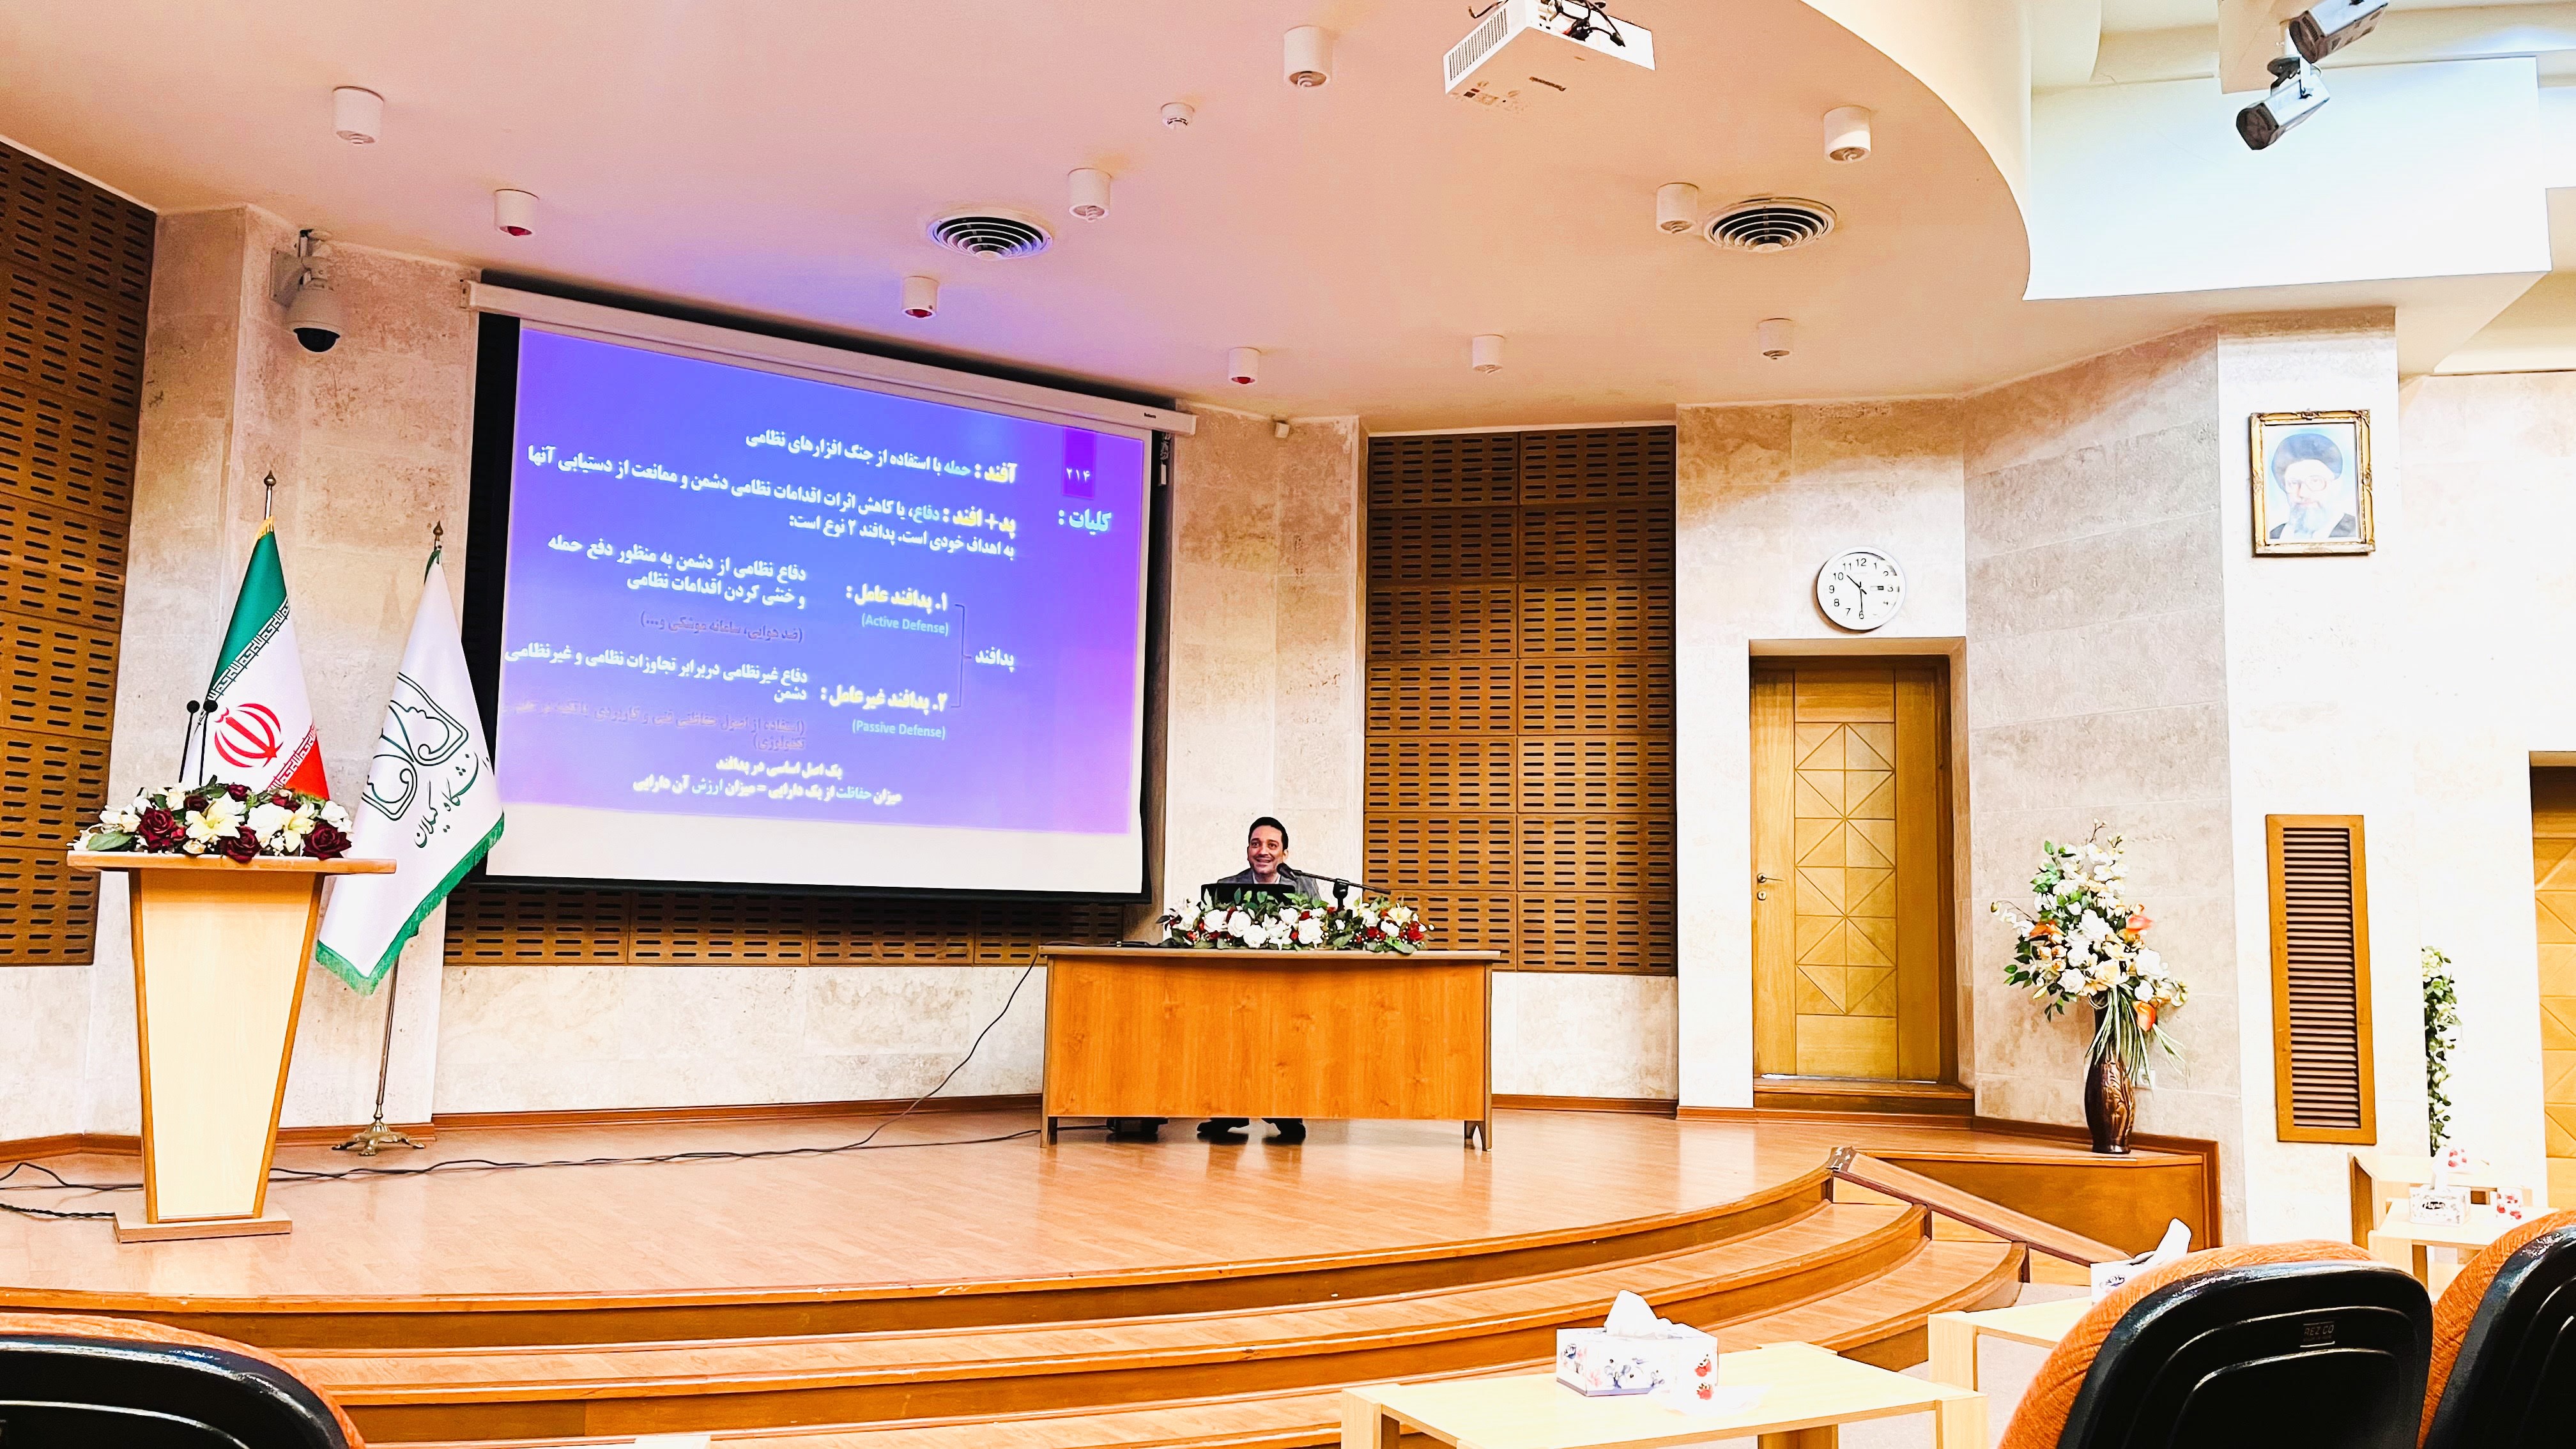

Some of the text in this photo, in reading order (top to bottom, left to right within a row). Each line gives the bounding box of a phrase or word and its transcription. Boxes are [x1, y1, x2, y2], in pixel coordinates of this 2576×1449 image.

[746, 429, 786, 447] نظامی
[528, 445, 557, 466] آنها
[558, 452, 614, 473] دستیابی
[844, 445, 874, 464] جنگ
[875, 449, 887, 467] از
[890, 452, 931, 470] استفاده
[615, 459, 631, 479] از
[631, 463, 678, 482] ممانعت
[932, 457, 942, 476] با
[944, 460, 972, 476] حمله
[983, 462, 1018, 484] آفند
[680, 475, 689, 489] و
[691, 473, 730, 491] دشمن
[731, 479, 771, 496] نظامی
[774, 484, 822, 503] اقدامات
[824, 492, 856, 512] اثرات
[858, 497, 894, 515] کاهش
[823, 519, 847, 537] نوع
[1069, 509, 1114, 535] کلیات
[859, 523, 896, 546] پدافند
[930, 535, 965, 553] خودی
[967, 537, 1002, 555] اهداف
[1002, 535, 1016, 561] به
[548, 535, 806, 583] دفاع نظامی از دشمن به منظور دفع حمله
[1856, 558, 1867, 567] 12
[1833, 572, 1844, 581] 10
[627, 570, 806, 610] و خنثی کردن اقدامات نظامی
[854, 583, 889, 606] عامل
[1828, 585, 1835, 594] 9
[891, 587, 933, 614] پدافند
[1846, 608, 1851, 616] 7
[862, 613, 950, 637] (Active Defense)
[574, 652, 583, 664] و
[585, 649, 625, 666] نظامی
[627, 654, 676, 674] تجاوزات
[976, 647, 1016, 673] پدافند
[781, 668, 808, 686] دفاع
[774, 687, 808, 702] دشمن
[887, 689, 930, 716] پدافند
[852, 719, 946, 740] (Passive Defense)
[672, 774, 690, 794] آن
[692, 778, 723, 795] ارزش
[824, 785, 836, 801] از
[836, 786, 872, 799] حفاظت
[873, 788, 903, 806] میزان
